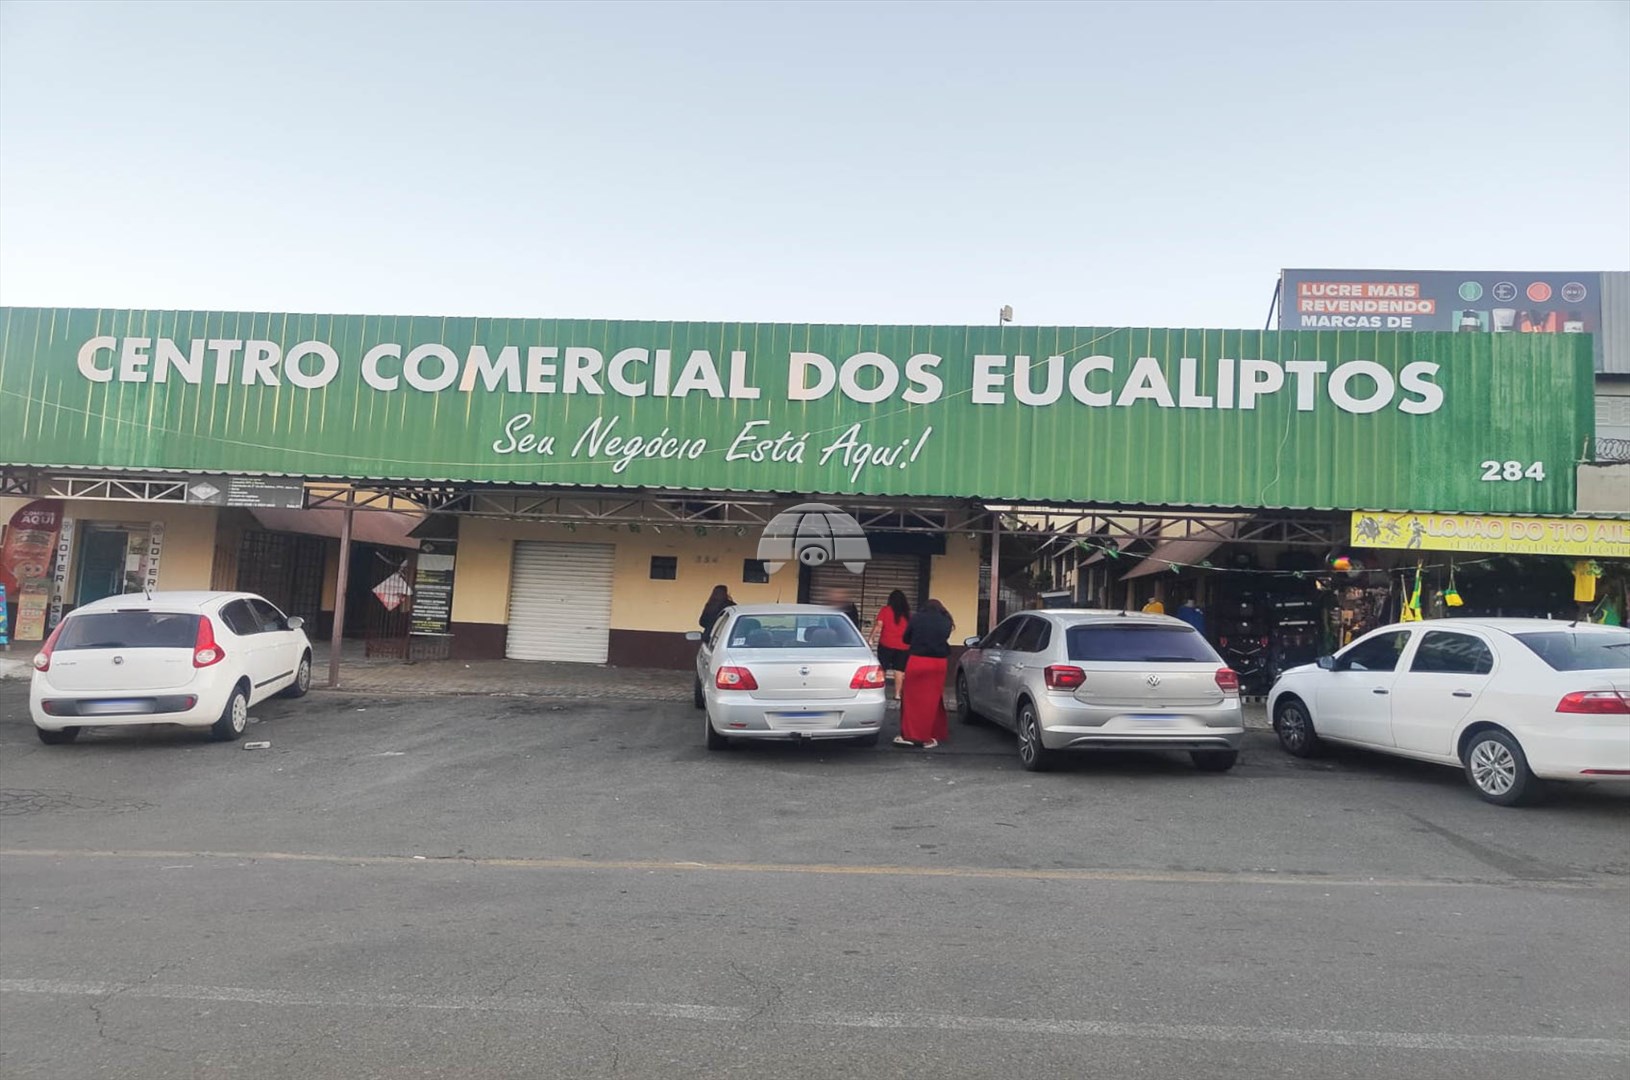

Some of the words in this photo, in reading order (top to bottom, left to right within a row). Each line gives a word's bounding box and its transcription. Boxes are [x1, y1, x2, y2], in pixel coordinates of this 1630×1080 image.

[1301, 284, 1362, 297] LUCRE
[1368, 285, 1416, 297] MAIS
[1301, 299, 1432, 313] REVENDENDO
[1301, 314, 1382, 328] MARCAS
[1387, 316, 1413, 328] DE
[77, 336, 340, 389] CENTRO
[361, 343, 761, 400] COMERCIAL
[787, 351, 943, 404] DOS
[971, 354, 1444, 415] EUCALIPTOS
[493, 413, 554, 456] Seu
[571, 415, 707, 473] Negócio
[725, 420, 811, 463] Está
[819, 423, 932, 484] Aqui!
[1480, 460, 1546, 481] 284
[21, 512, 55, 525] AQUI
[1428, 517, 1505, 539] LOJÃO
[1509, 521, 1545, 541] DO
[1549, 521, 1589, 543] TIO
[51, 533, 69, 614] LOTERIAS
